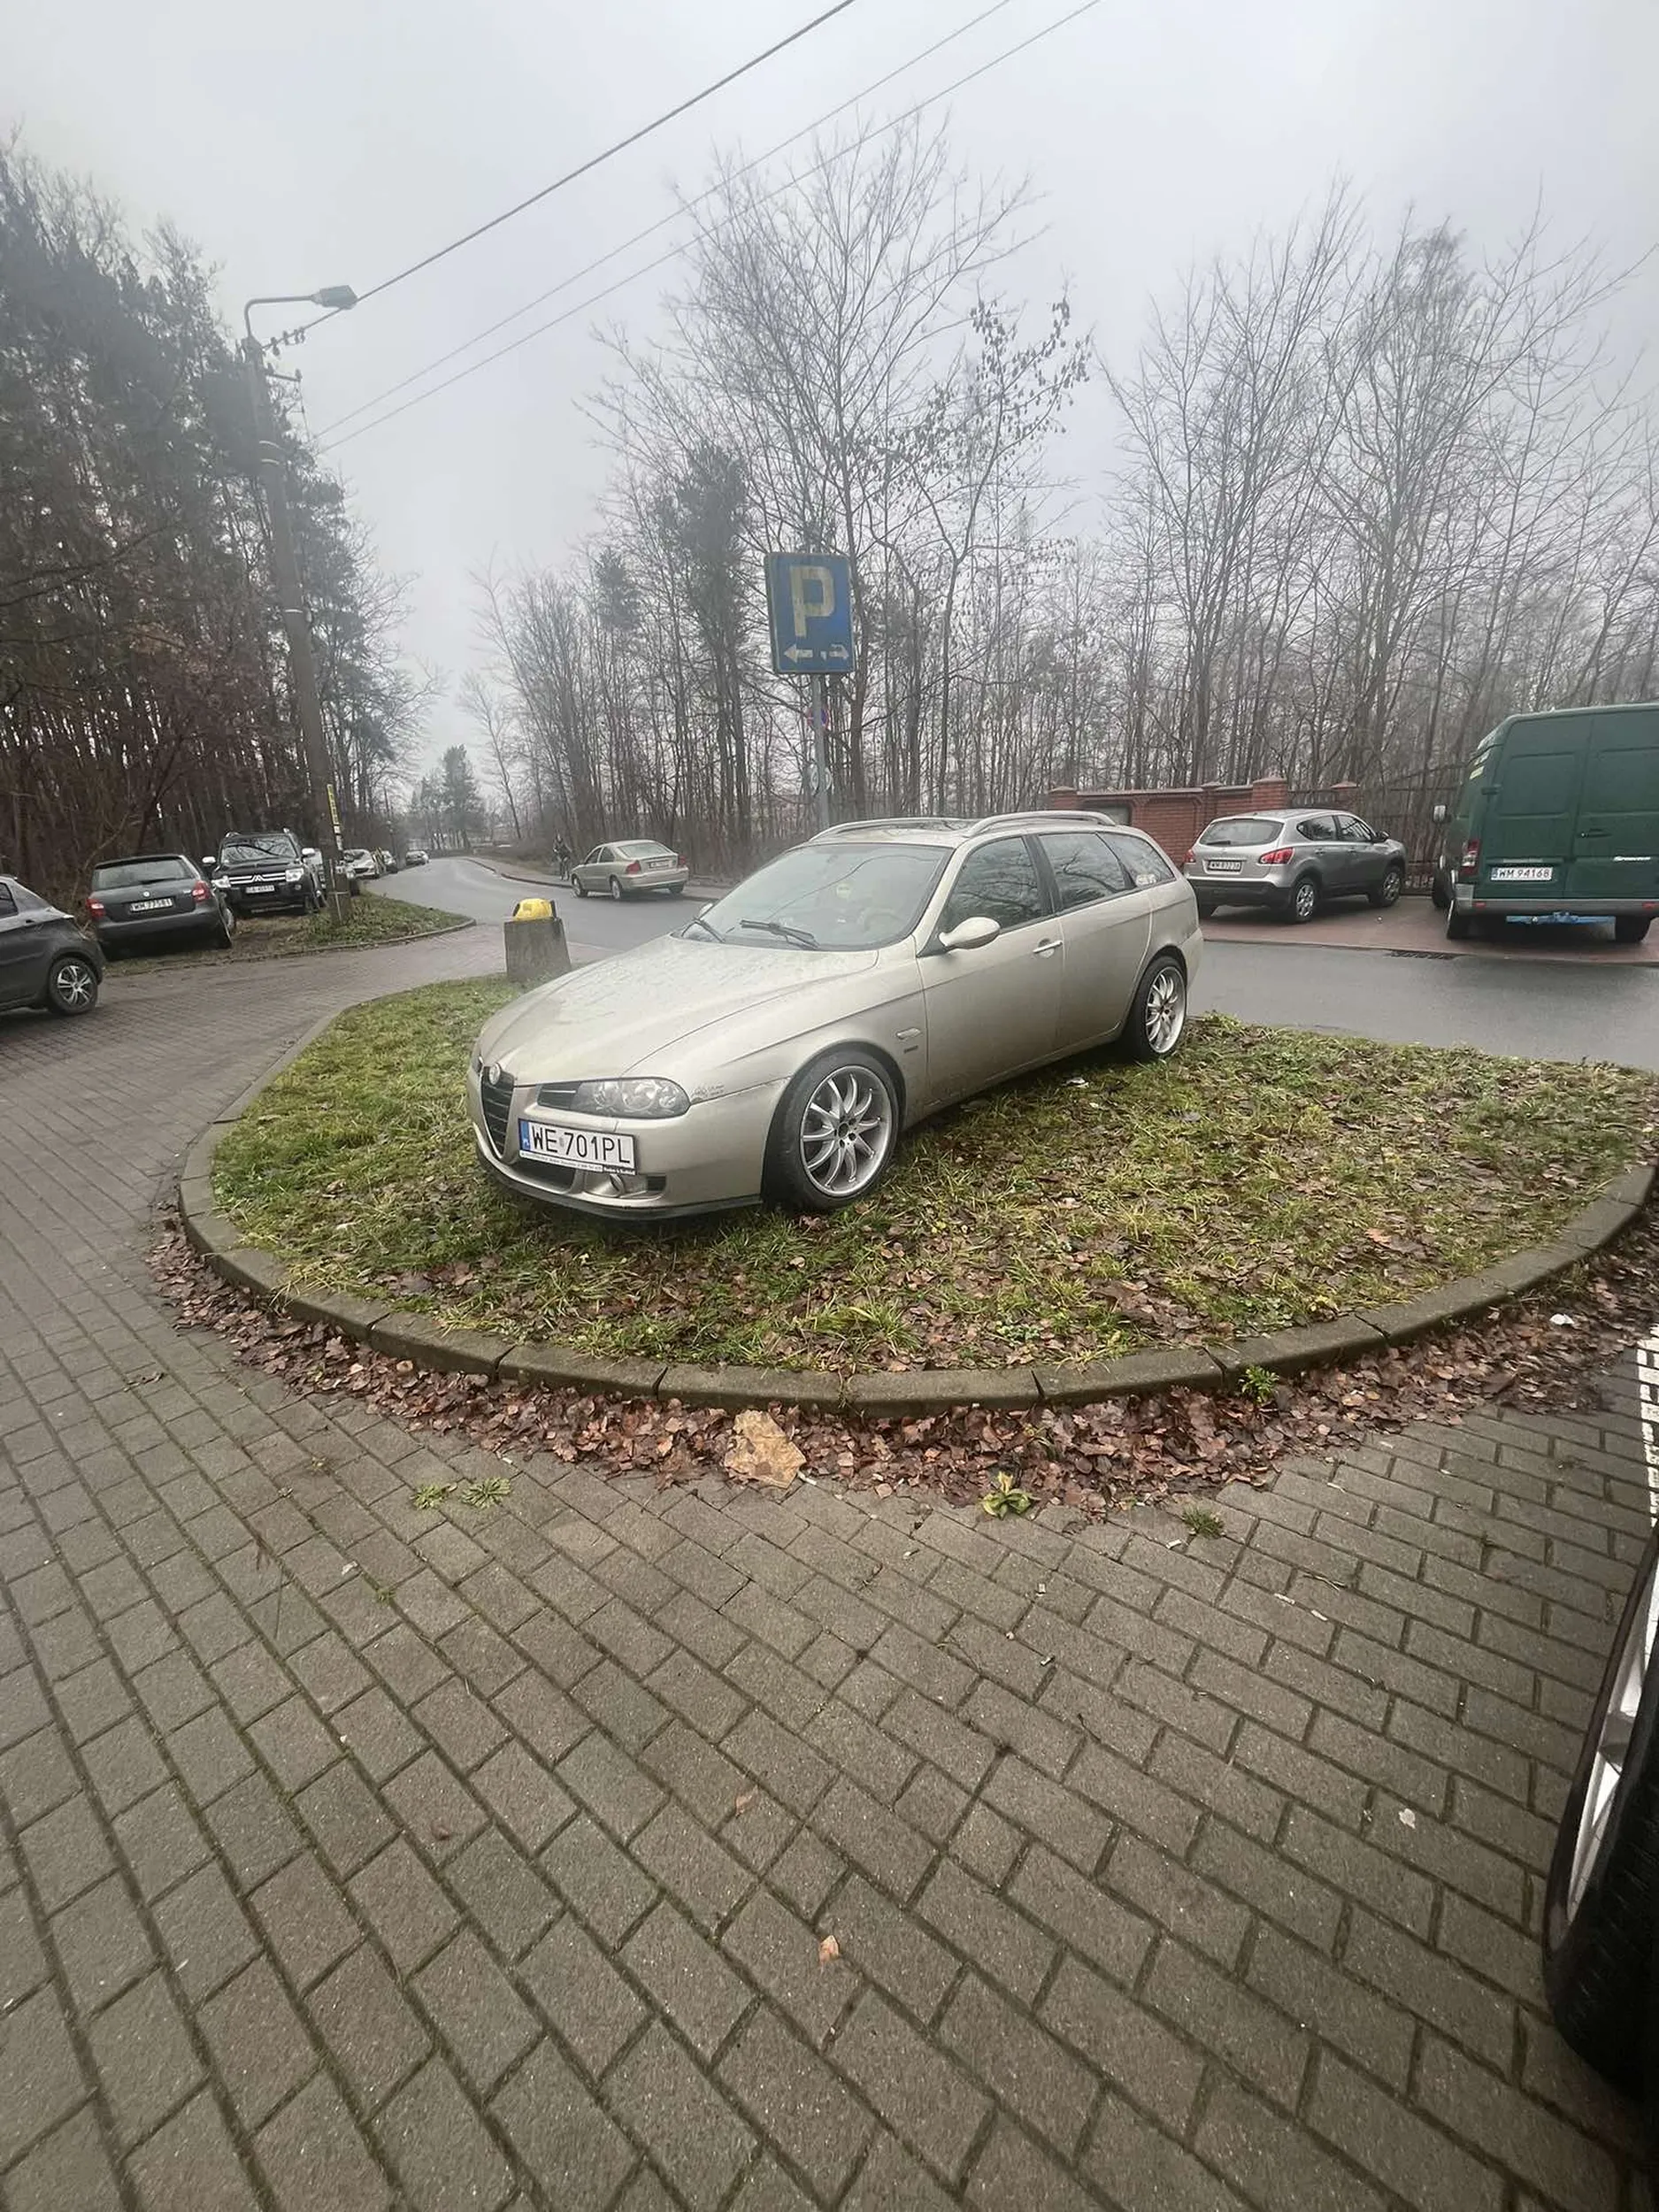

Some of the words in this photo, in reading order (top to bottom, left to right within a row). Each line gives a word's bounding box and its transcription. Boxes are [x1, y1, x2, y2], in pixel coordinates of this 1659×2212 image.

[790, 565, 834, 637] P
[1499, 869, 1515, 879] WM
[1517, 868, 1550, 879] 94168
[532, 1126, 558, 1153] WE
[564, 1132, 631, 1164] 701PL
